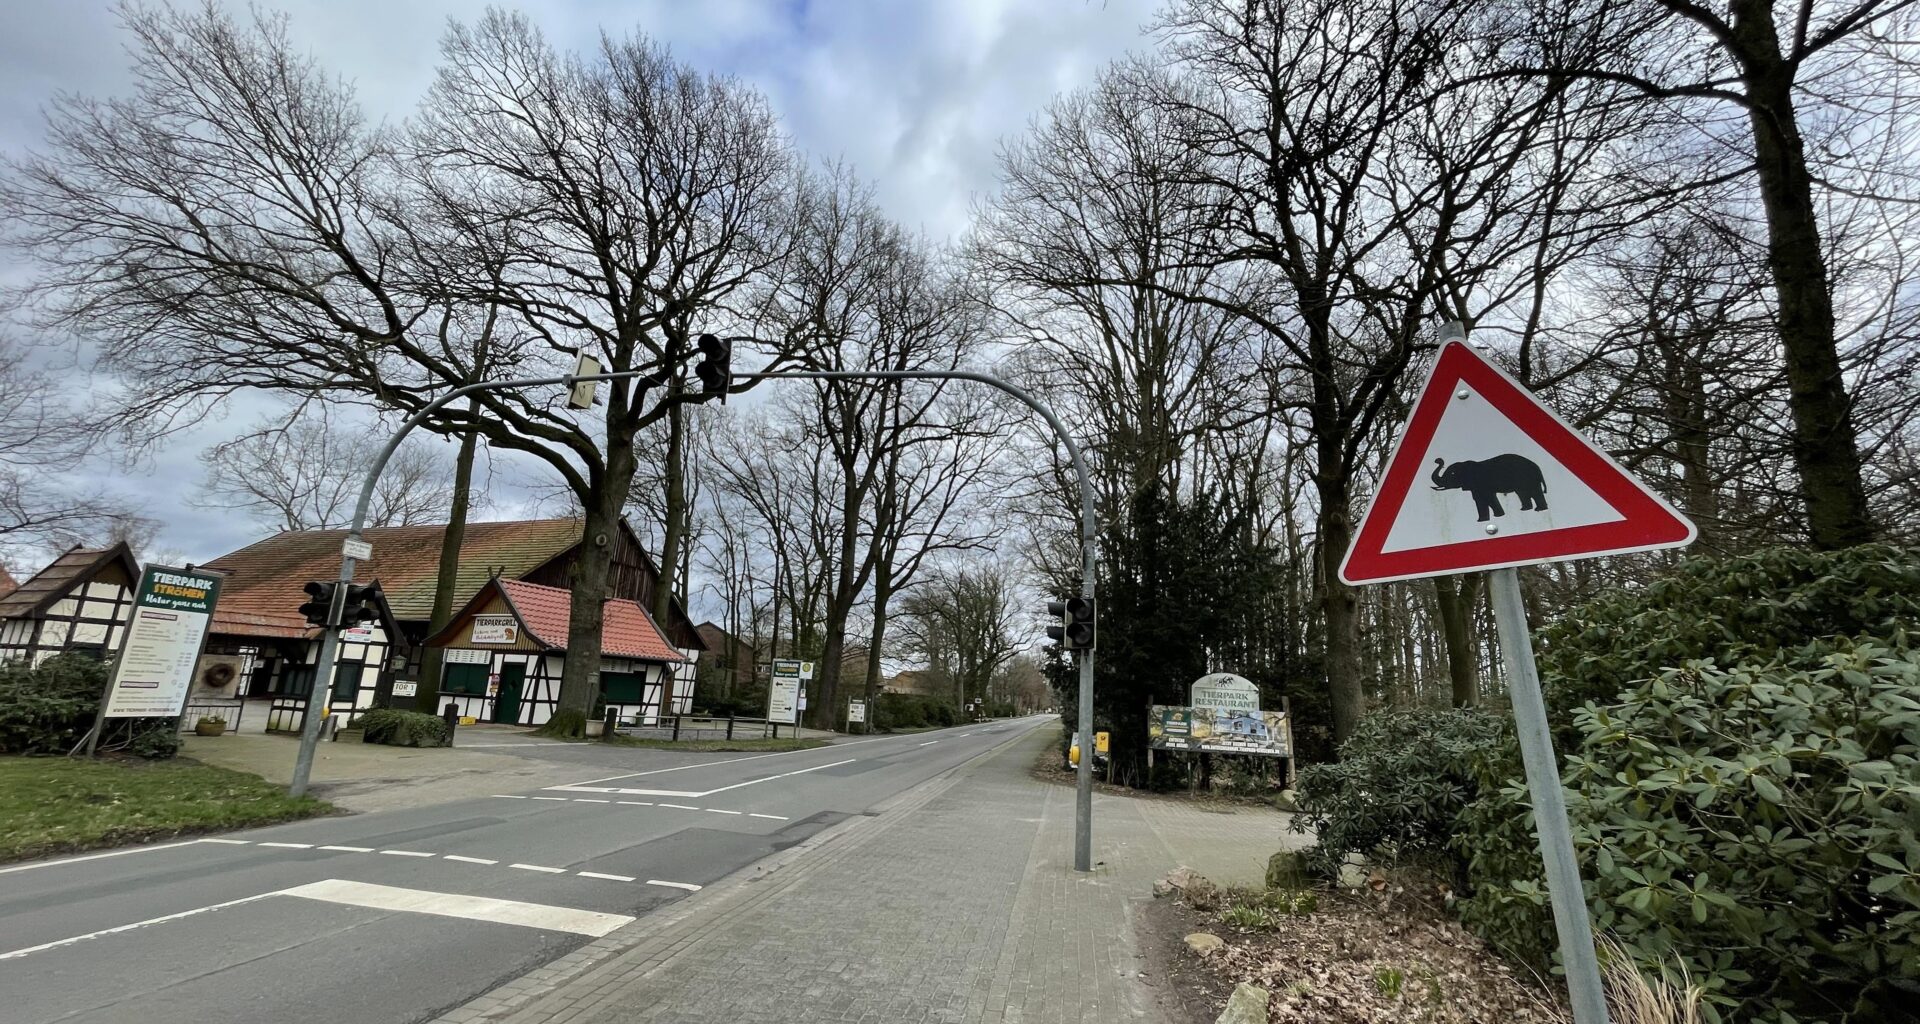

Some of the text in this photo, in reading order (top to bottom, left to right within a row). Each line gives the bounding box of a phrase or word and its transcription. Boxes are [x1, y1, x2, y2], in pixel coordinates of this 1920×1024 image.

[153, 572, 214, 590] TIERPARK
[145, 593, 207, 610] Natur ganz nah
[476, 618, 517, 627] TIERPARKGRILL
[395, 683, 409, 691] TOR
[1201, 690, 1249, 701] TIERPARK
[1195, 698, 1257, 708] RESTAURANT
